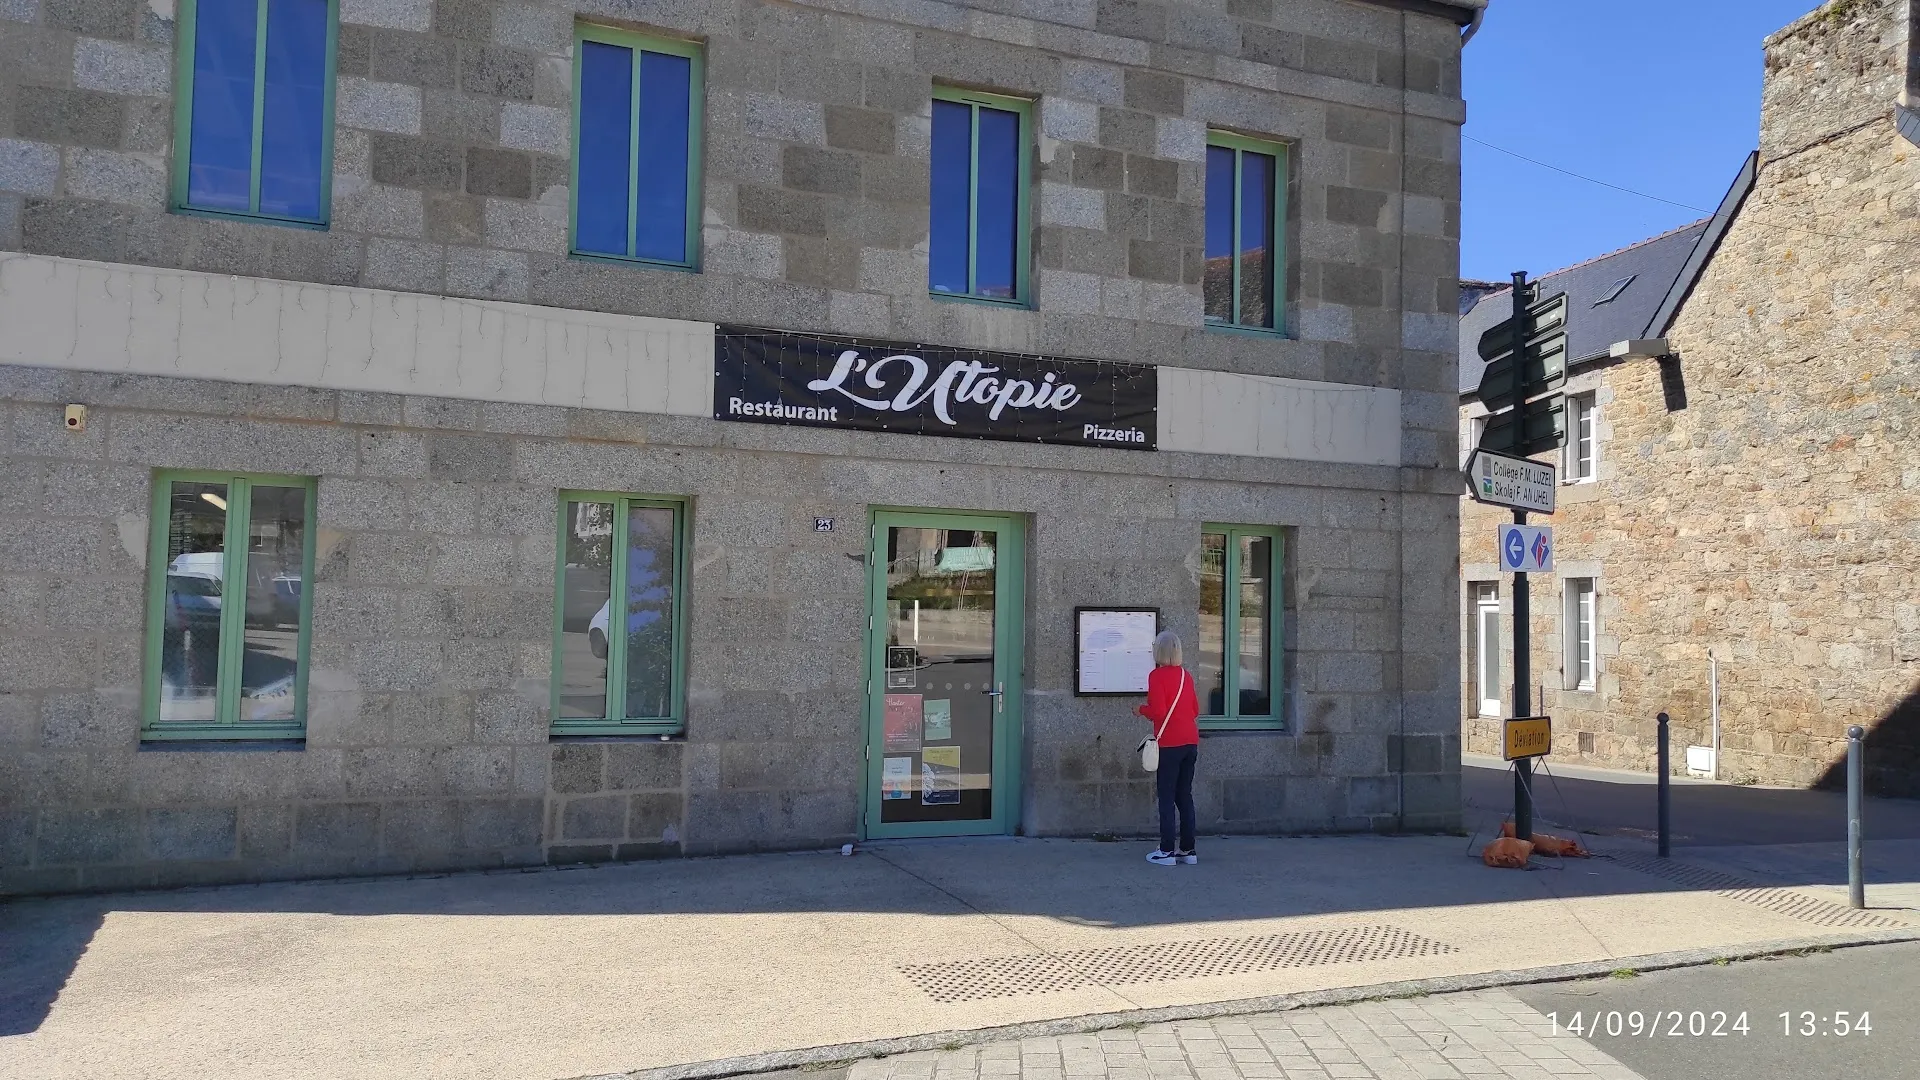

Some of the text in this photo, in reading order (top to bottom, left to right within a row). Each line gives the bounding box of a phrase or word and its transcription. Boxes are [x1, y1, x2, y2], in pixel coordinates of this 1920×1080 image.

[807, 350, 1081, 425] L'Utopie
[729, 397, 838, 421] Restaurant
[1083, 424, 1145, 443] Pizzeria
[1493, 461, 1519, 483] Collège
[1533, 470, 1552, 487] LUZEL
[1494, 481, 1516, 502] Skolaj
[1522, 488, 1532, 503] AN
[817, 519, 832, 530] 23
[1514, 728, 1545, 748] Déviation
